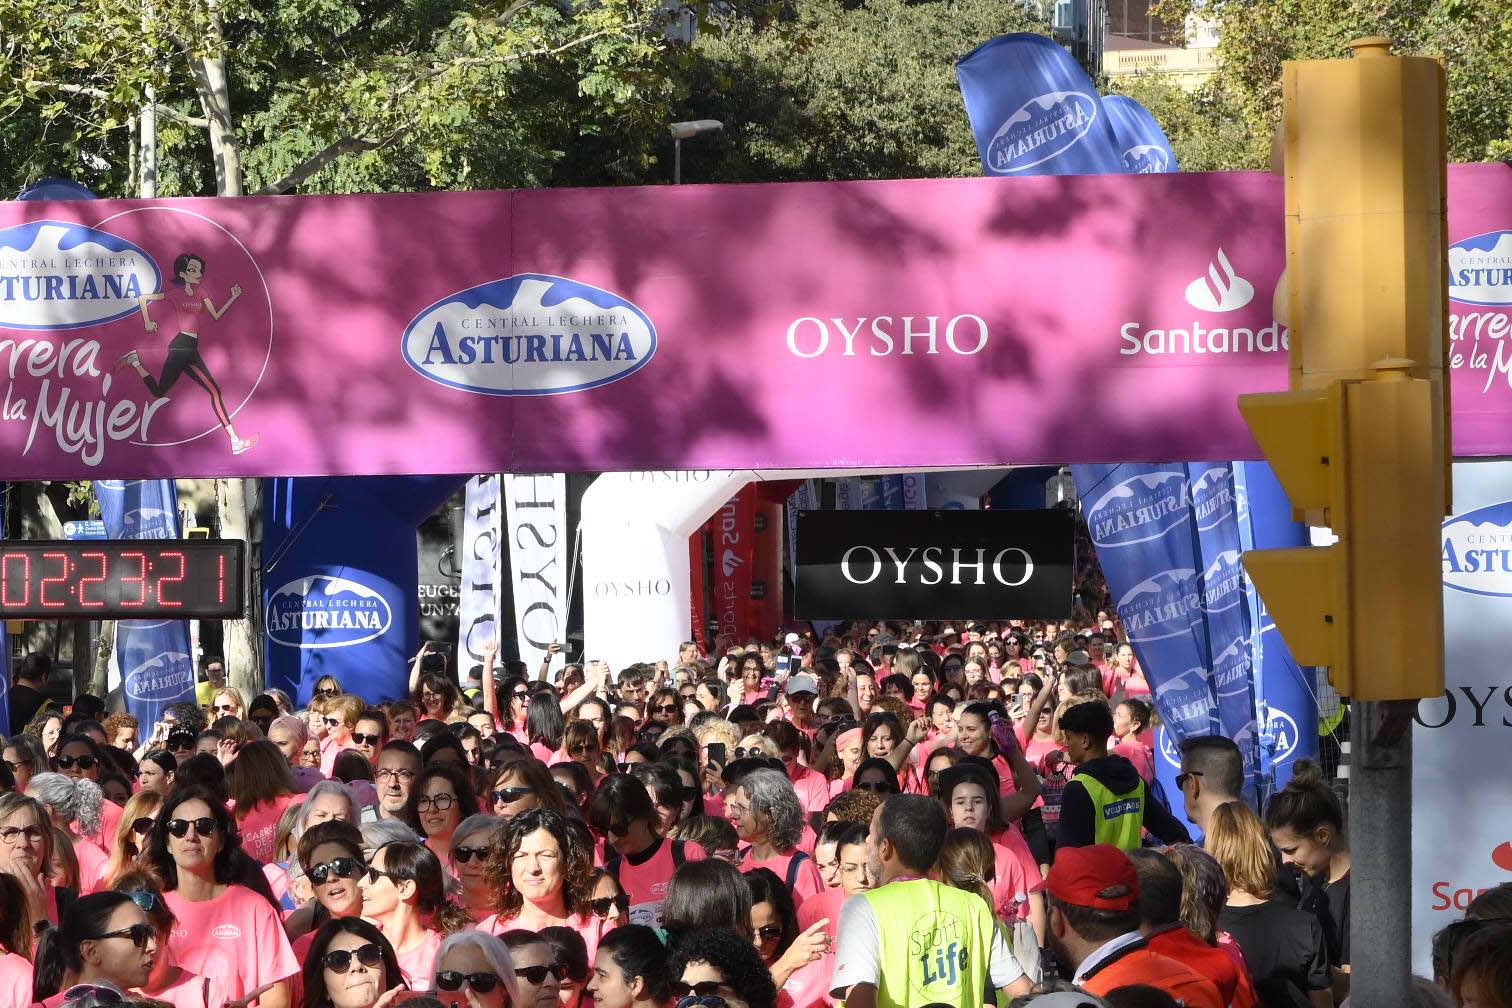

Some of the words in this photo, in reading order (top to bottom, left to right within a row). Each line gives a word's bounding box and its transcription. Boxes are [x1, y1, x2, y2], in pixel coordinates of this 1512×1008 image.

[65, 256, 137, 268] LECHERA
[460, 317, 539, 329] CENTRAL
[548, 315, 627, 327] LECHERA
[787, 313, 989, 358] OYSHO
[421, 321, 637, 365] ASTURIANA
[1470, 341, 1488, 369] la
[2, 382, 27, 421] la
[23, 373, 170, 467] Mujer
[1, 552, 224, 607] 02:23:21
[840, 545, 1034, 587] OYSHO
[282, 600, 327, 609] CENTRAL
[328, 599, 378, 608] LECHERA
[594, 577, 670, 598] OYSHO
[270, 606, 383, 631] ASTURIANA
[911, 920, 960, 956] Sport
[921, 942, 968, 987] Life
